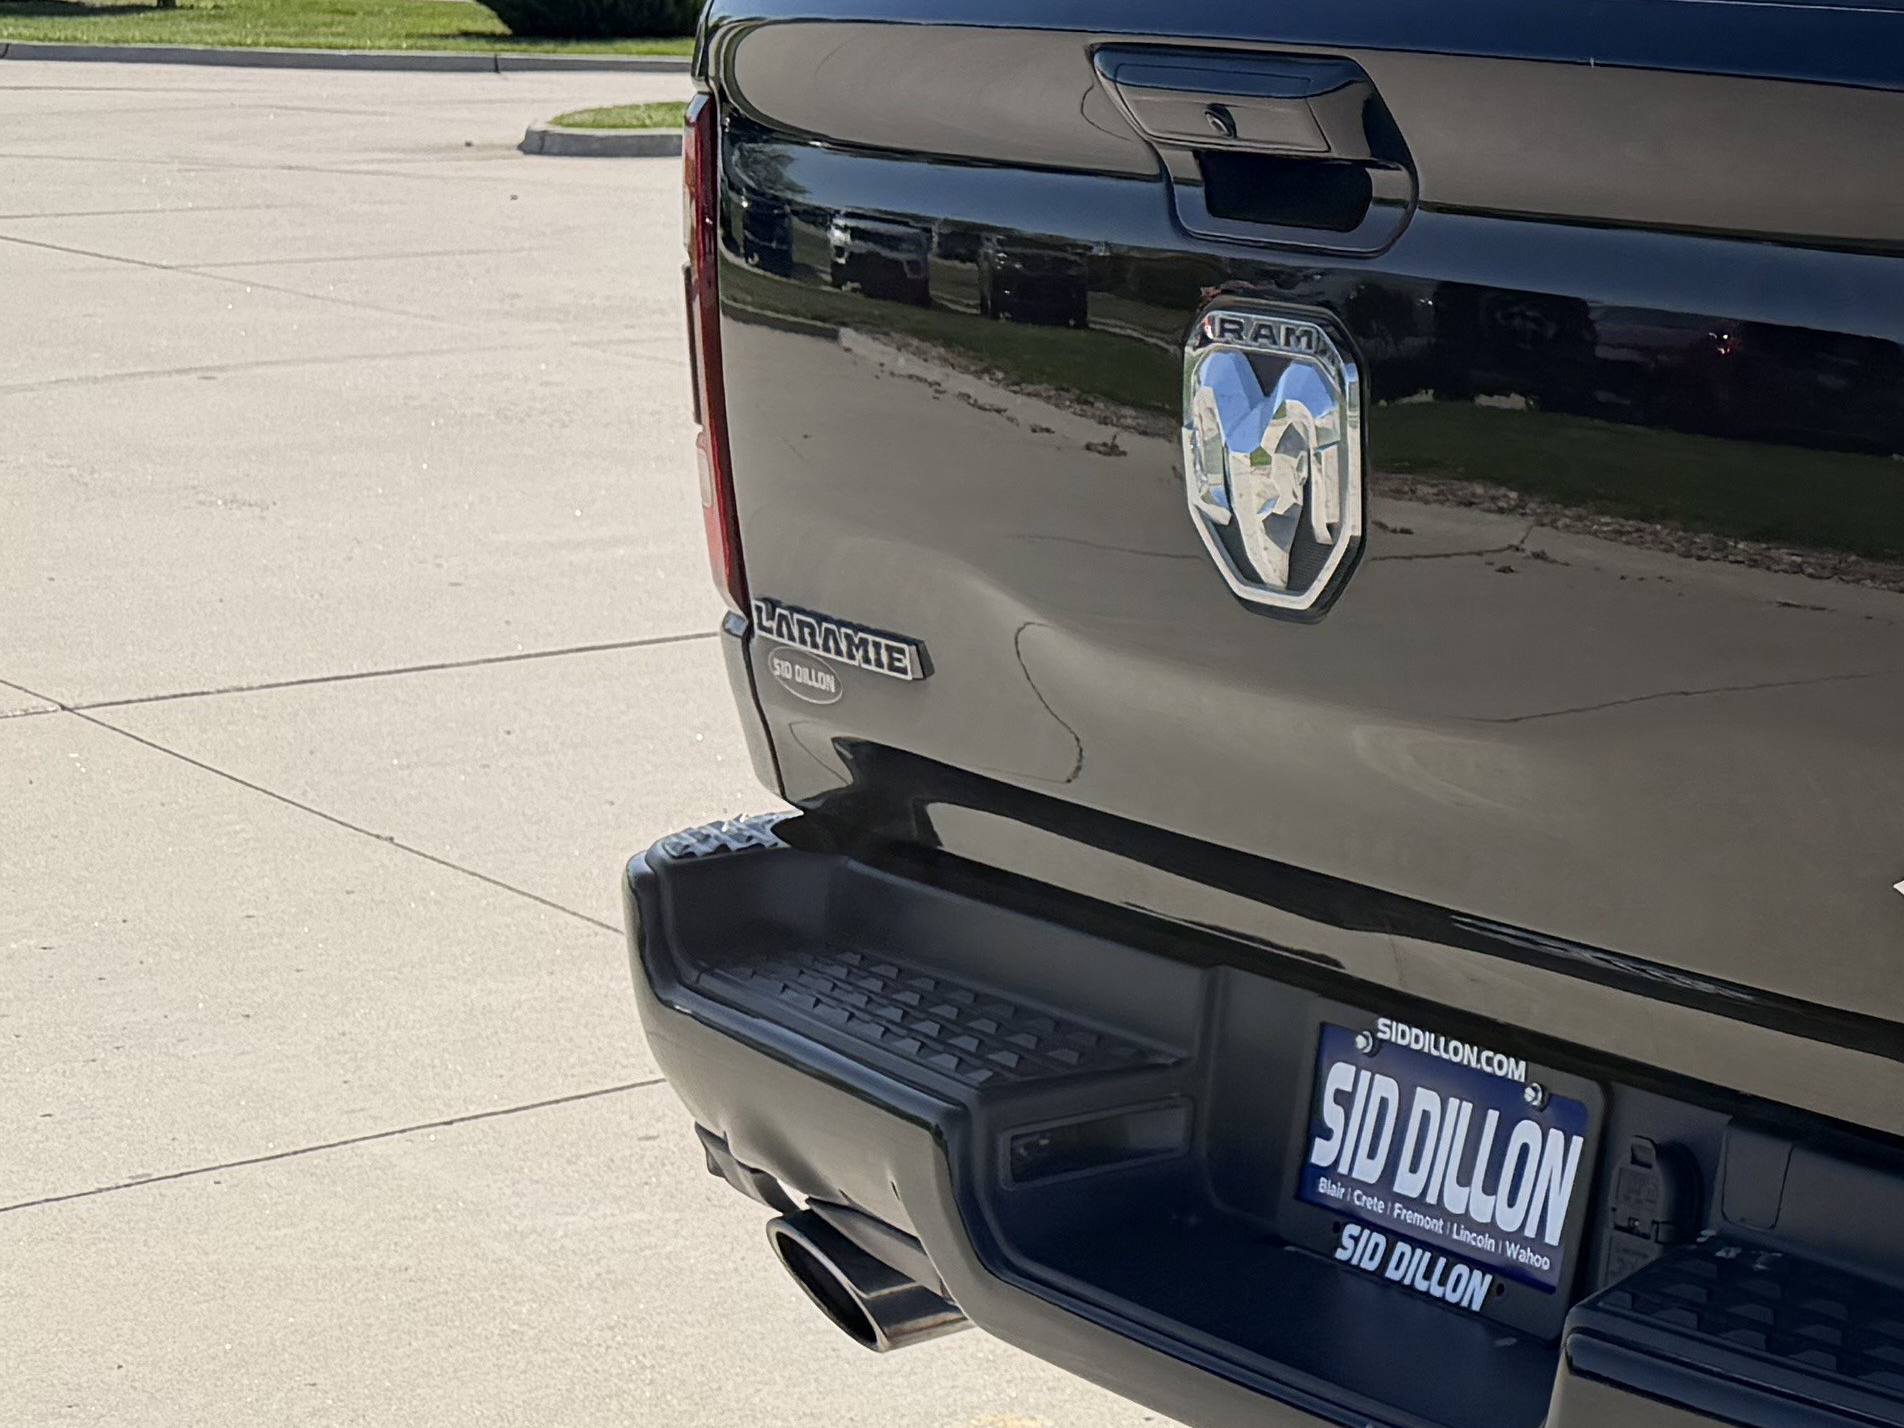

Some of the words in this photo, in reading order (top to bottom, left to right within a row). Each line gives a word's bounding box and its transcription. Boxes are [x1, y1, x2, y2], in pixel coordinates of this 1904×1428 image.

[1215, 316, 1318, 352] RAM
[752, 598, 914, 681] LARAMIE
[772, 656, 793, 678] SID
[794, 663, 837, 693] DILLON
[1376, 1016, 1528, 1083] SIDDILLON.COM
[1310, 1061, 1400, 1185] SID
[1392, 1085, 1585, 1247] DILLON
[1317, 1176, 1346, 1201] Blair
[1353, 1189, 1385, 1215] Crete
[1393, 1203, 1445, 1235] Fremont
[1452, 1224, 1496, 1254] Lincoln
[1505, 1240, 1551, 1271] Wahoo
[1334, 1223, 1388, 1272] SID
[1384, 1241, 1494, 1313] DILLON
